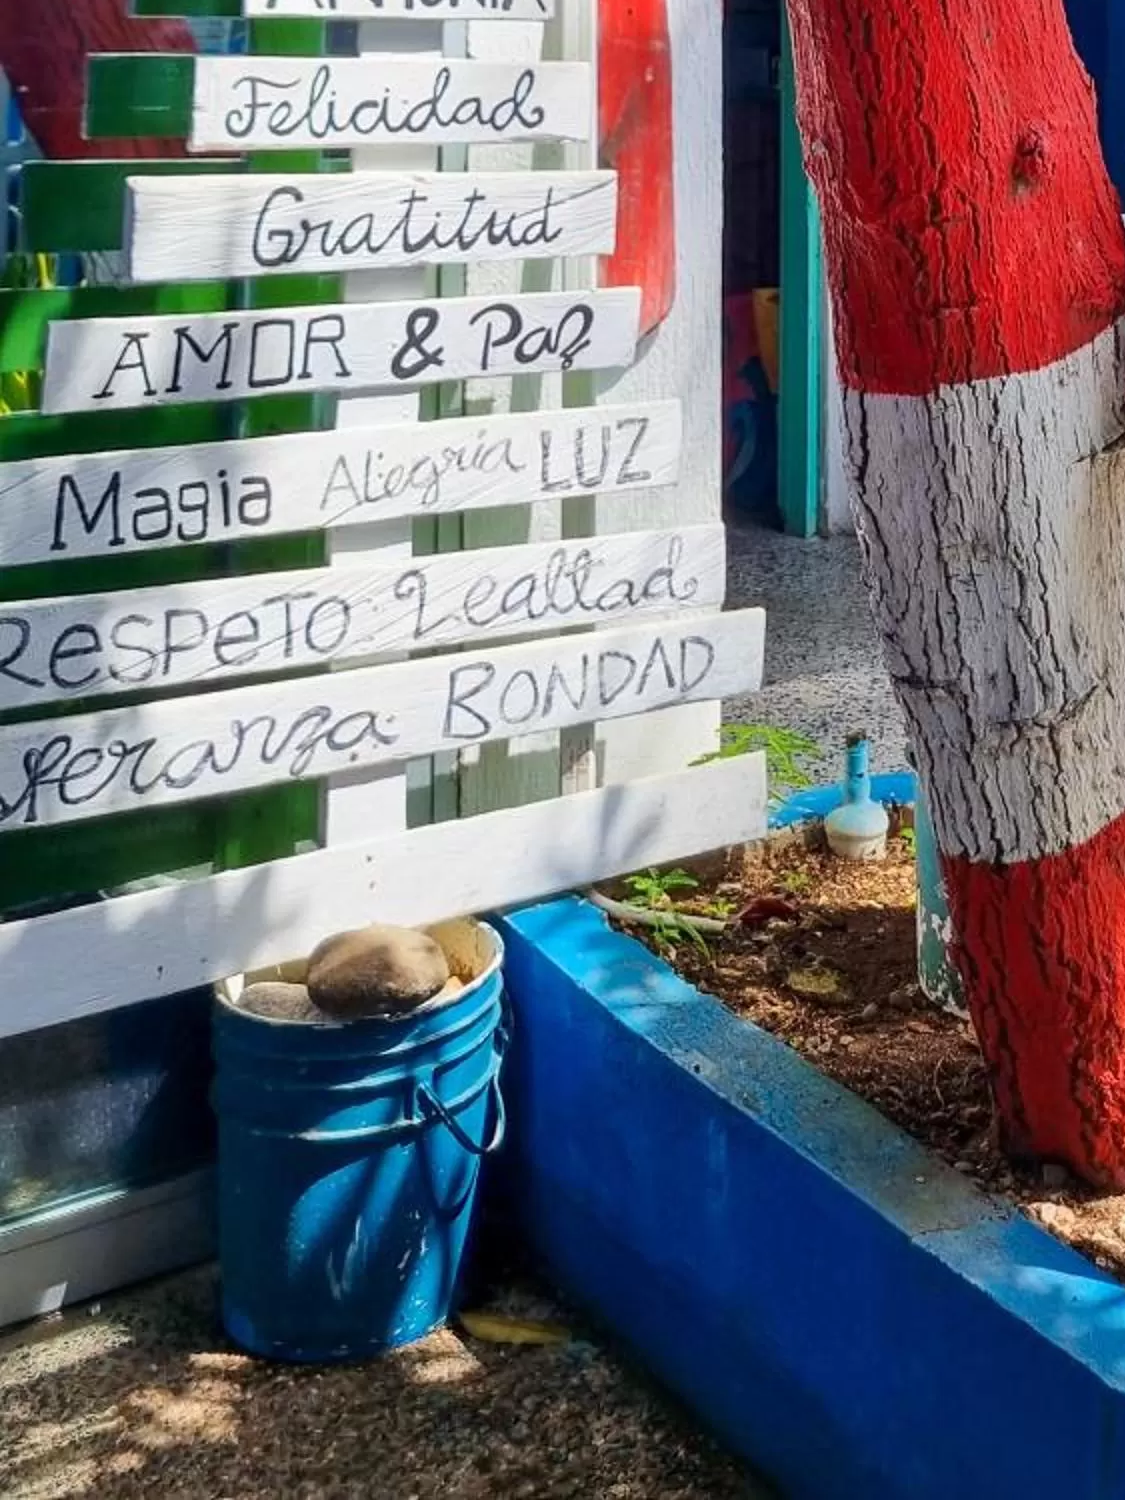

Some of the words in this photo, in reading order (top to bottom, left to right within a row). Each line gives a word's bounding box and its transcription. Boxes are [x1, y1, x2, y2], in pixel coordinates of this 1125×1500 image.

[225, 63, 545, 139] Felicidad
[252, 185, 564, 267] Gratitud
[92, 313, 353, 399] AMOR
[390, 306, 445, 379] &
[468, 302, 595, 371] Paz
[50, 471, 273, 551] Magia
[539, 416, 653, 492] LUZ
[442, 636, 716, 739] BONDAD
